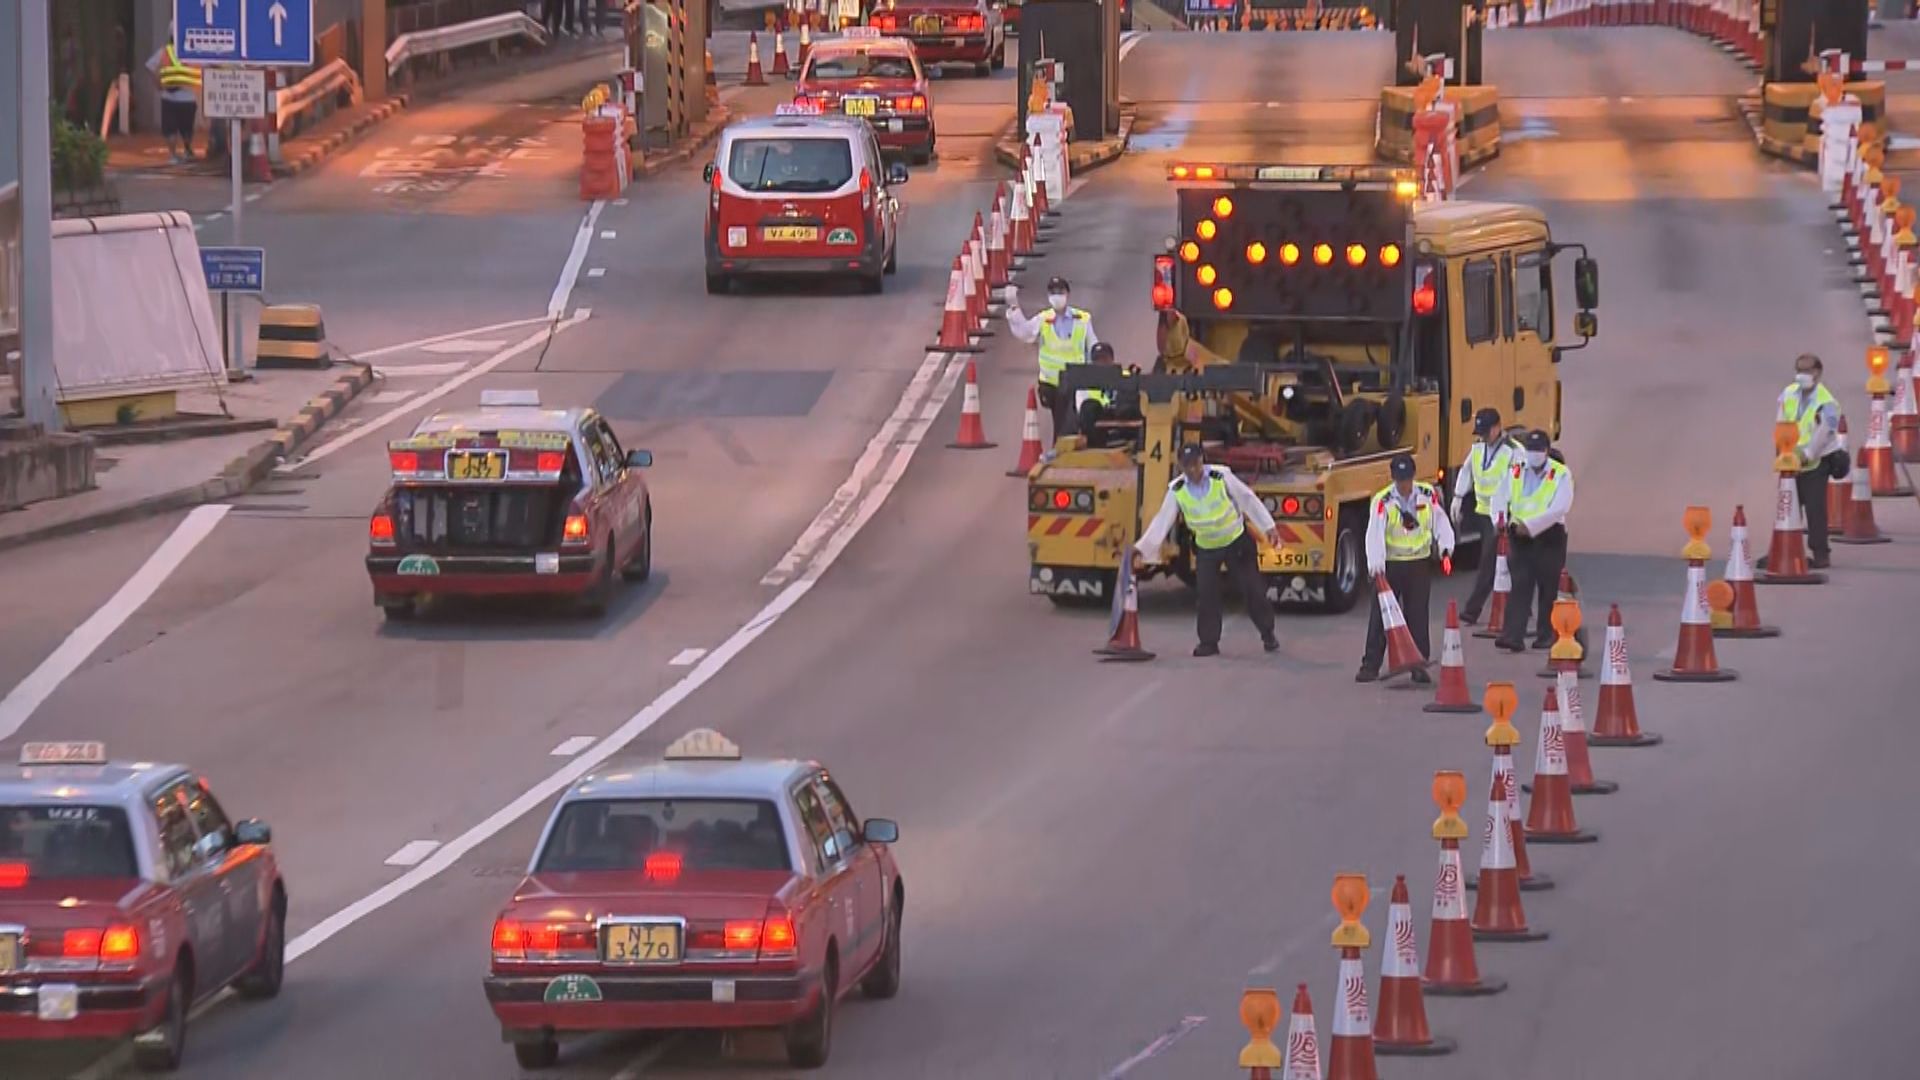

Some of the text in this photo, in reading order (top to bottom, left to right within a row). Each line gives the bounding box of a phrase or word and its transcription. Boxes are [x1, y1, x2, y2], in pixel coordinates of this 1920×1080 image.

[1150, 439, 1162, 463] 4
[1273, 552, 1309, 567] 3591
[628, 926, 655, 942] NT
[615, 942, 670, 958] 3470
